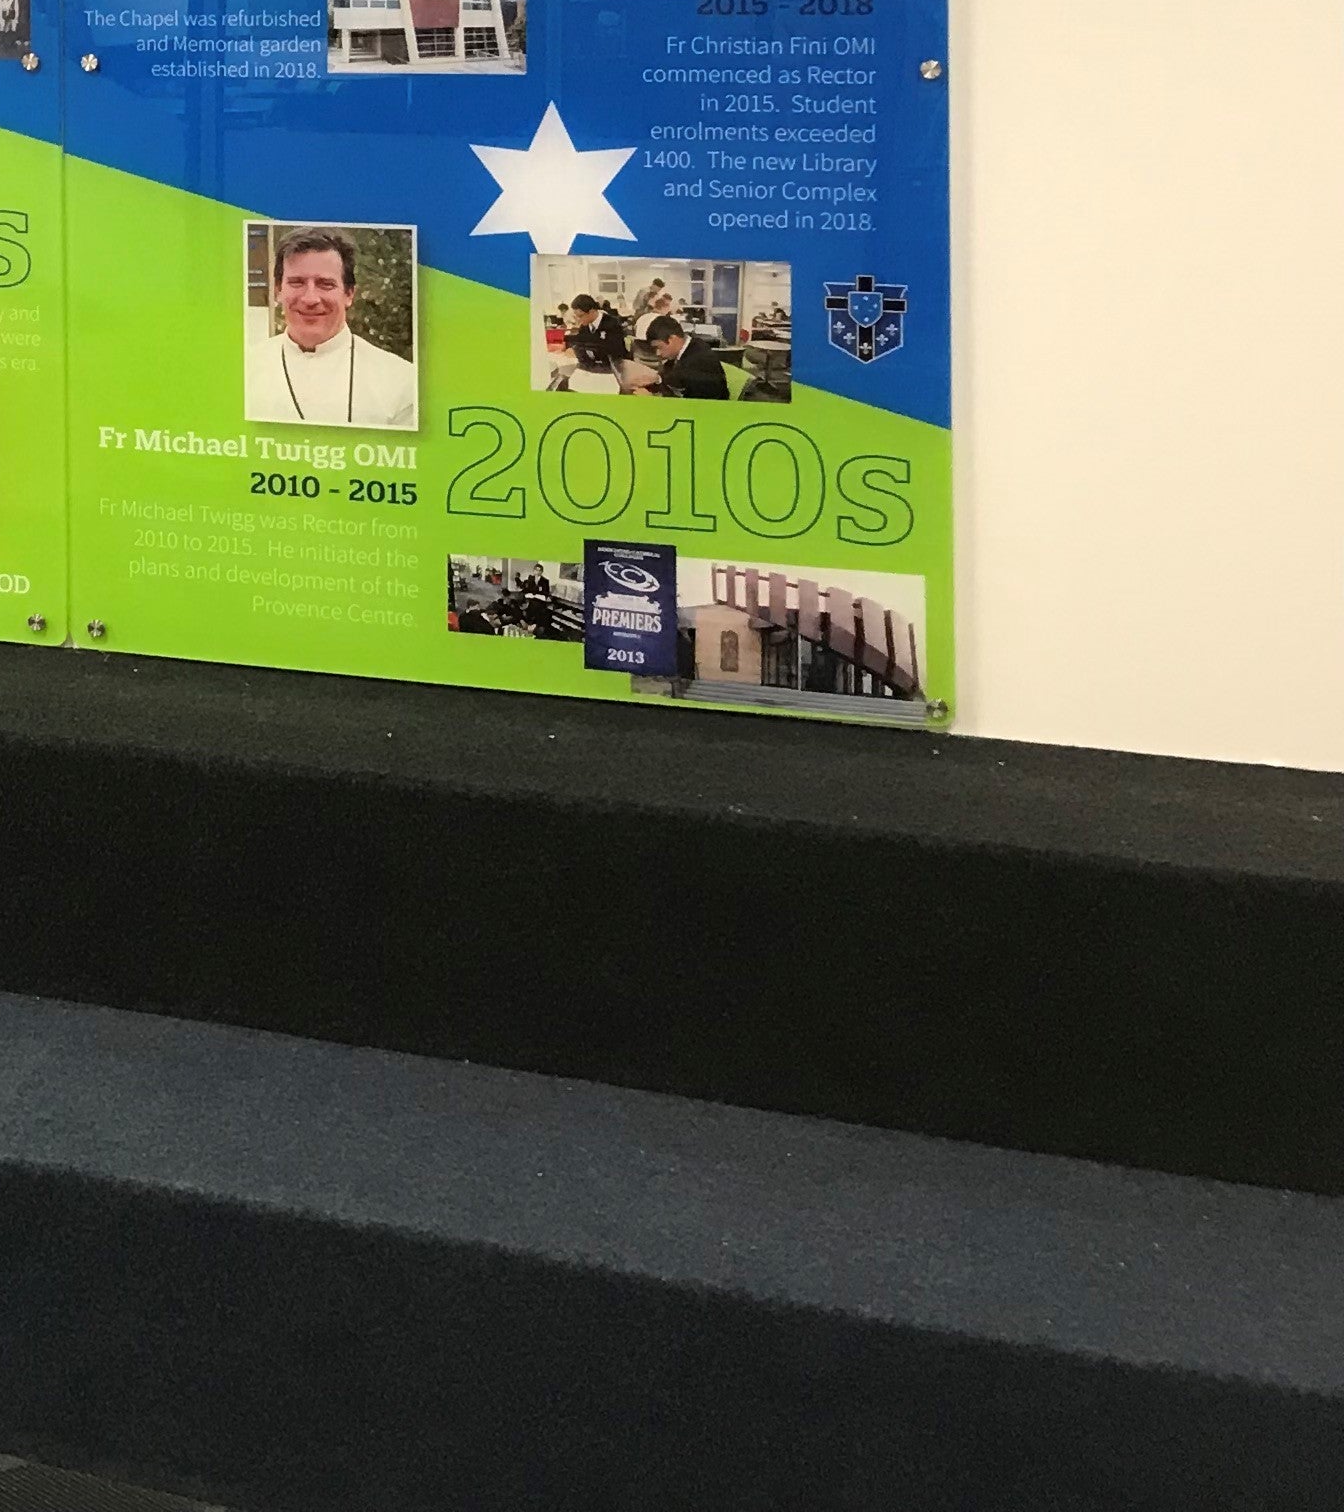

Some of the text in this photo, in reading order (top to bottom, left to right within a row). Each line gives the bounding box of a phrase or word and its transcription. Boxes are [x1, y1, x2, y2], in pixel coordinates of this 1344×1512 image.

[83, 9, 320, 29] The Chapel was refurbished
[136, 34, 321, 57] and Memorial garden
[667, 36, 875, 55] Fr Christian Fini OMI
[151, 60, 321, 78] established in 2018.
[642, 66, 876, 84] commenced as Rector
[700, 93, 876, 114] in 2015. Student
[650, 122, 875, 143] enrolments exceeded
[643, 150, 877, 177] 1400. The new Library
[663, 179, 877, 204] and Senior Complex
[708, 210, 876, 231] opened in 2018.
[98, 426, 416, 469] Fr Michael Twigg OMI
[446, 407, 914, 546] 2010s
[250, 472, 320, 497] 2010
[349, 479, 417, 505] 2015
[252, 595, 342, 620] Provence
[592, 608, 662, 632] PREMIERS
[607, 648, 644, 663] 2013
